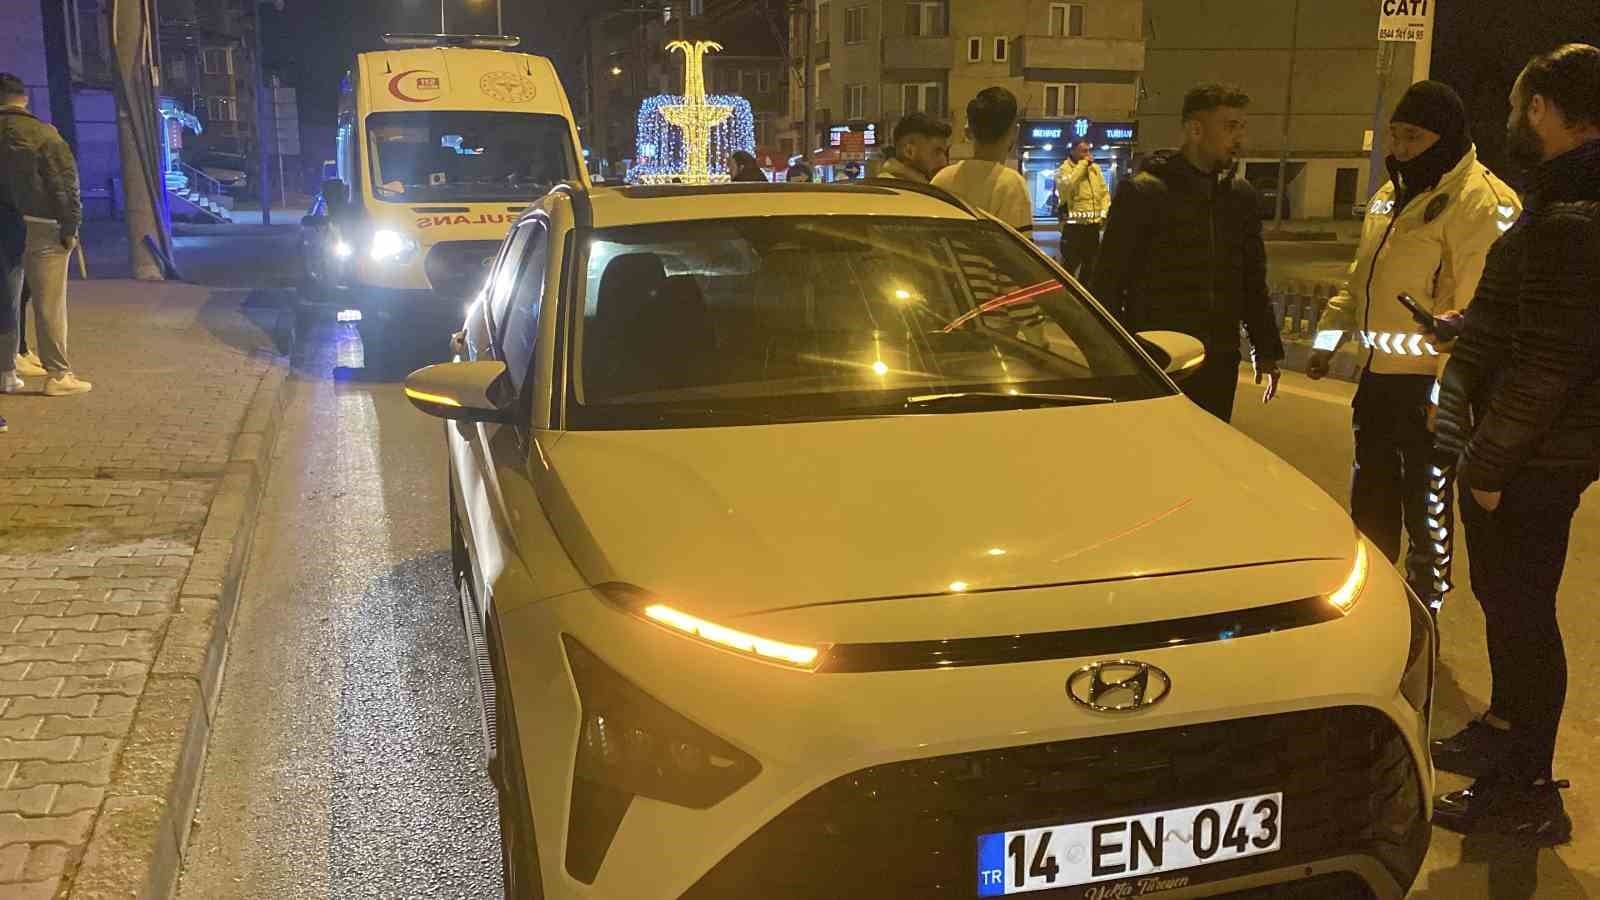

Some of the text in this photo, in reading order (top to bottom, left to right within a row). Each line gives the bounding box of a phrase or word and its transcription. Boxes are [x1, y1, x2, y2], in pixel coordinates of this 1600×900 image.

[1007, 799, 1279, 887] 14 EN 043
[981, 869, 1002, 885] TR
